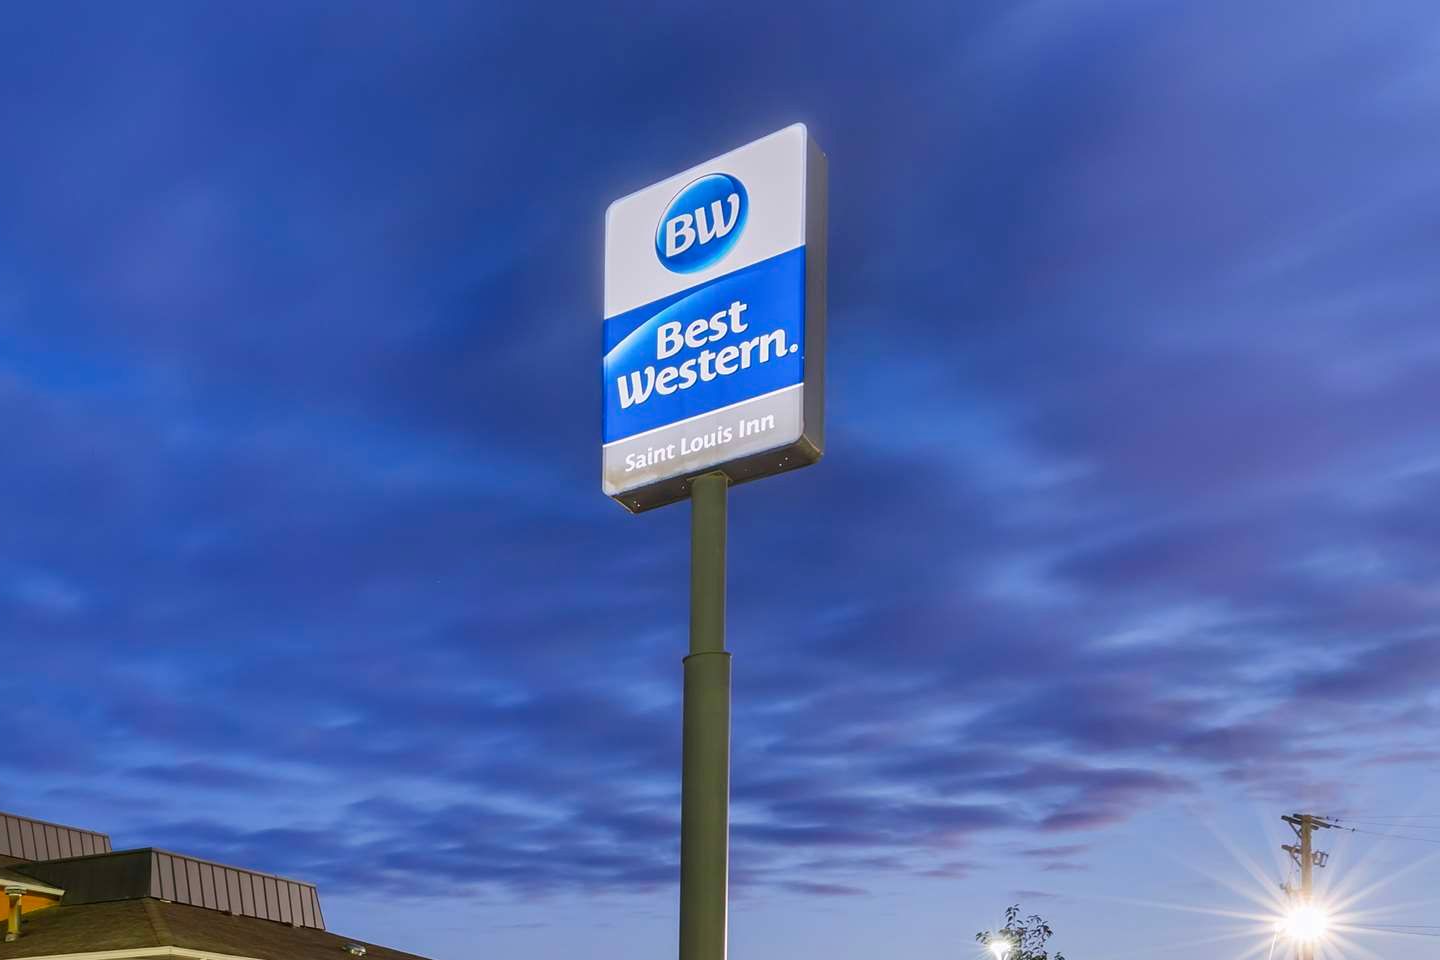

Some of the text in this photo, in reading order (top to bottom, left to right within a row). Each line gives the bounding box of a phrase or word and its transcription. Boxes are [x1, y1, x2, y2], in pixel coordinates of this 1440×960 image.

[666, 193, 740, 258] BW
[657, 301, 748, 360] Best
[625, 414, 775, 472] Saint Louis Inn
